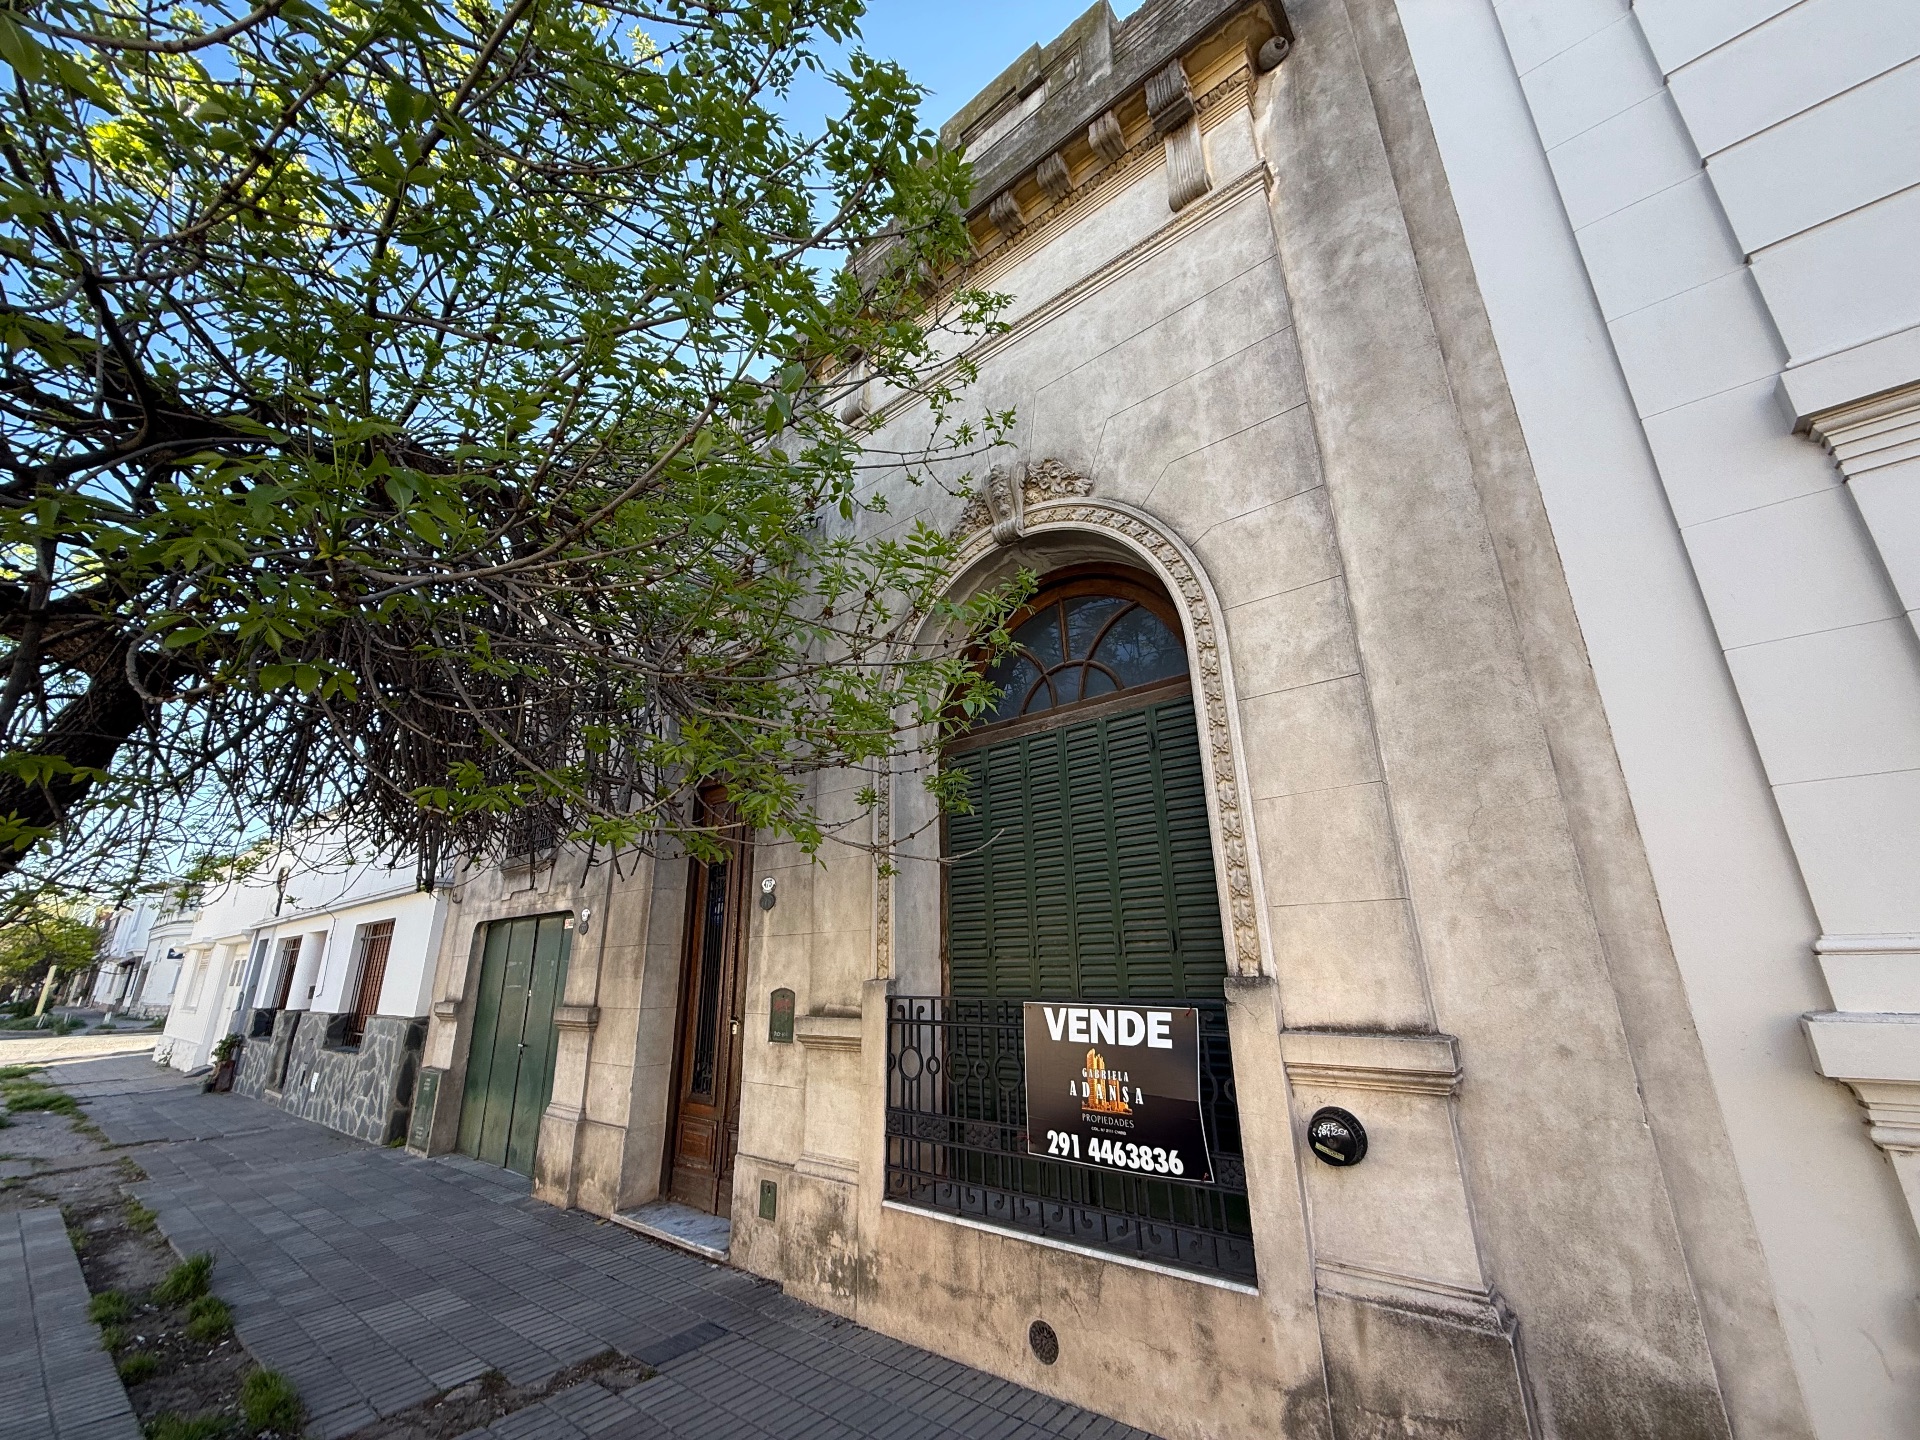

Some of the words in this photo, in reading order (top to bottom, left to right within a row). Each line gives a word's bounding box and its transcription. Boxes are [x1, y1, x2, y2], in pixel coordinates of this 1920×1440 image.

[1043, 1007, 1172, 1049] VENDE
[1082, 1067, 1129, 1082] GABRIELA
[1069, 1080, 1144, 1105] ADANSA
[1082, 1113, 1134, 1128] PROPIEDADES
[1047, 1130, 1080, 1158] 291
[1088, 1137, 1184, 1175] 4463836
